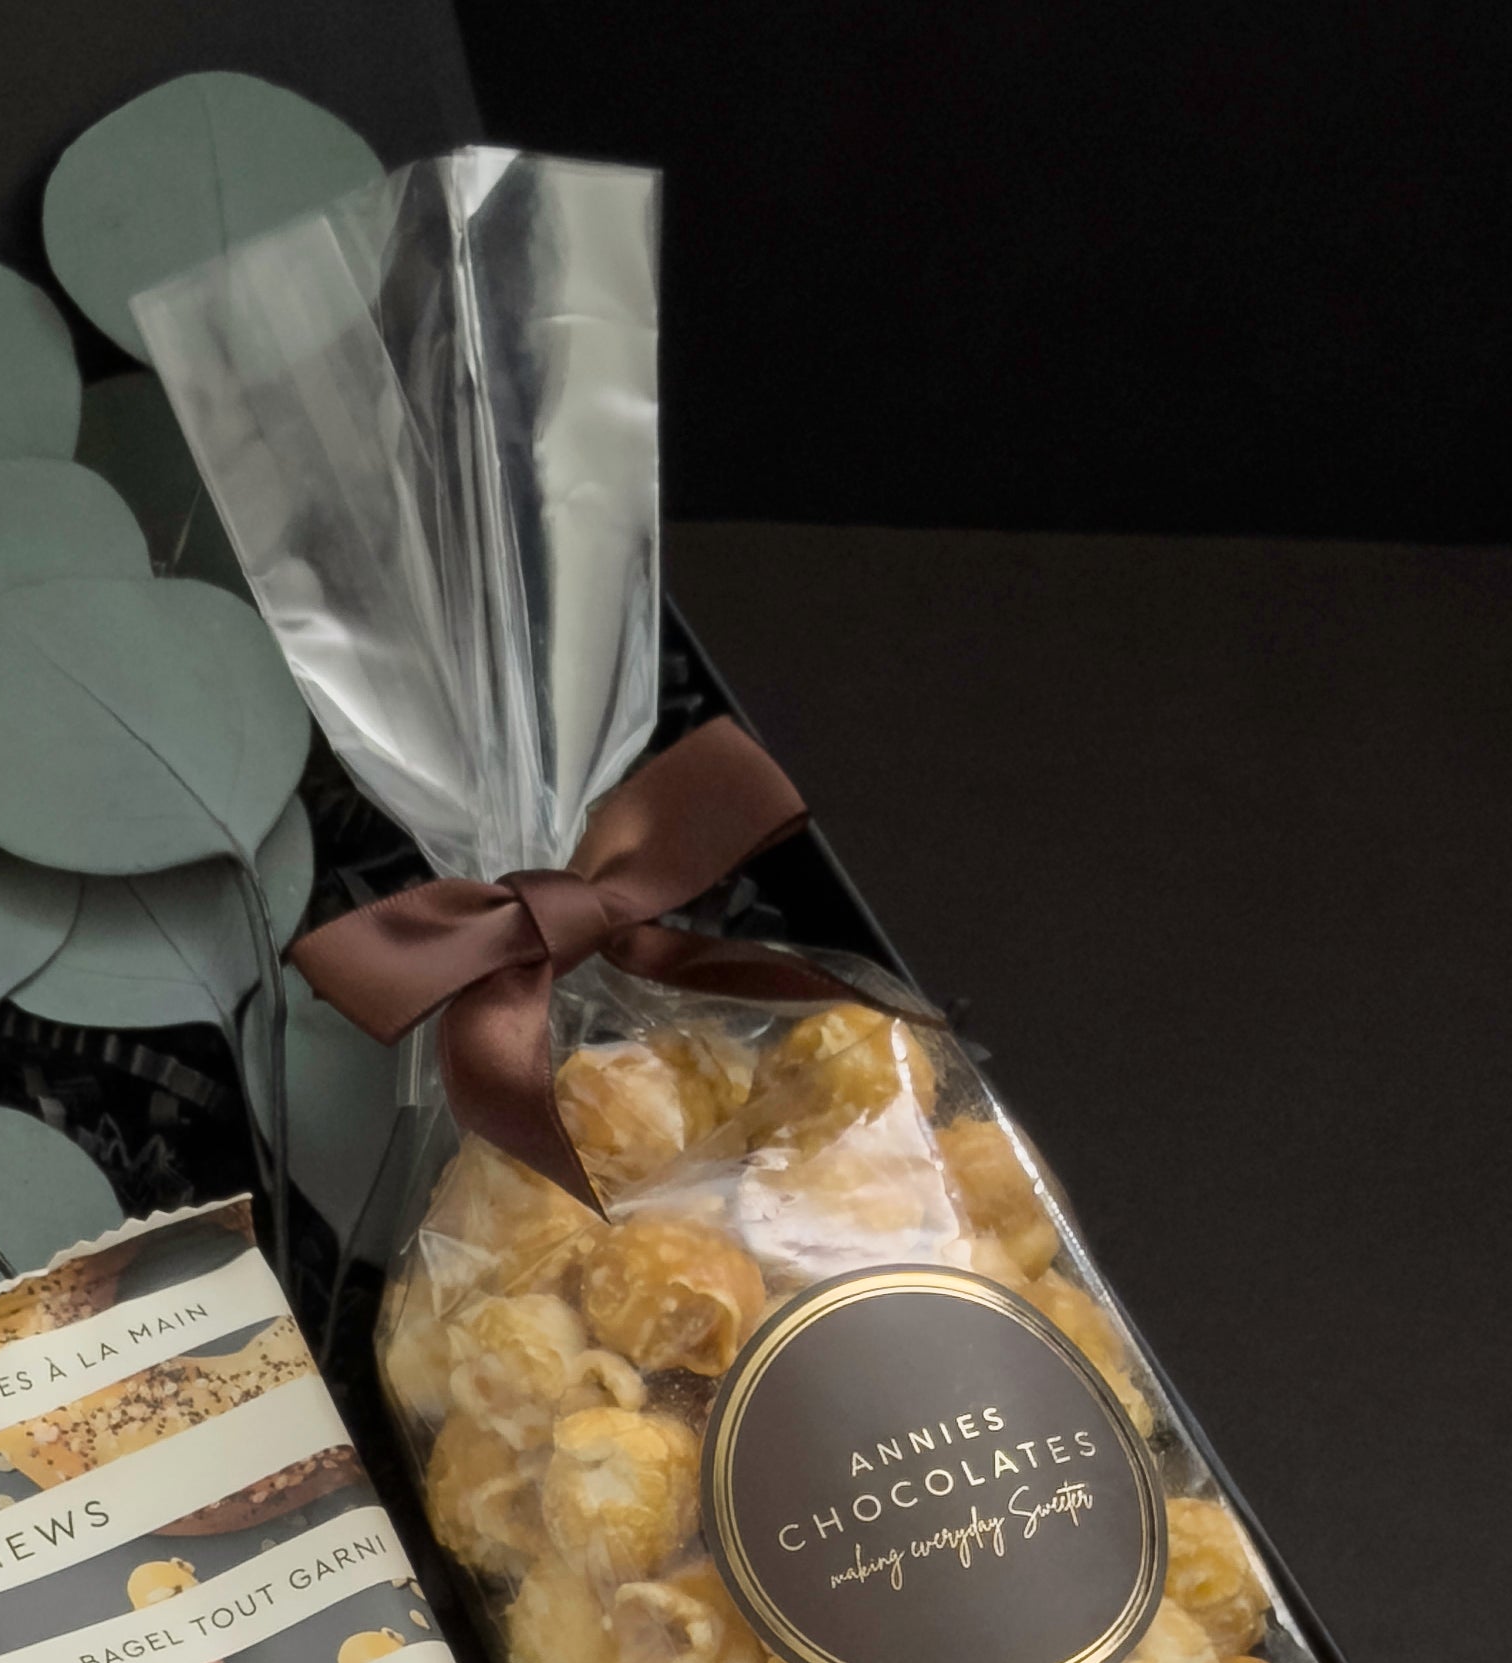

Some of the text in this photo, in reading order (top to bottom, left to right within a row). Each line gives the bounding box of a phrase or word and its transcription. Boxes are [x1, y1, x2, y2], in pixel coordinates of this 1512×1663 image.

[44, 1356, 68, 1383] À
[76, 1342, 119, 1369] LA
[127, 1303, 209, 1344] MAIN
[849, 1406, 1006, 1477] ANNIES
[778, 1431, 1096, 1552] CHOCOLATES
[189, 1583, 276, 1636] TOUT
[288, 1534, 388, 1589] GARNI
[830, 1545, 905, 1591] making
[911, 1505, 1005, 1568] everyday
